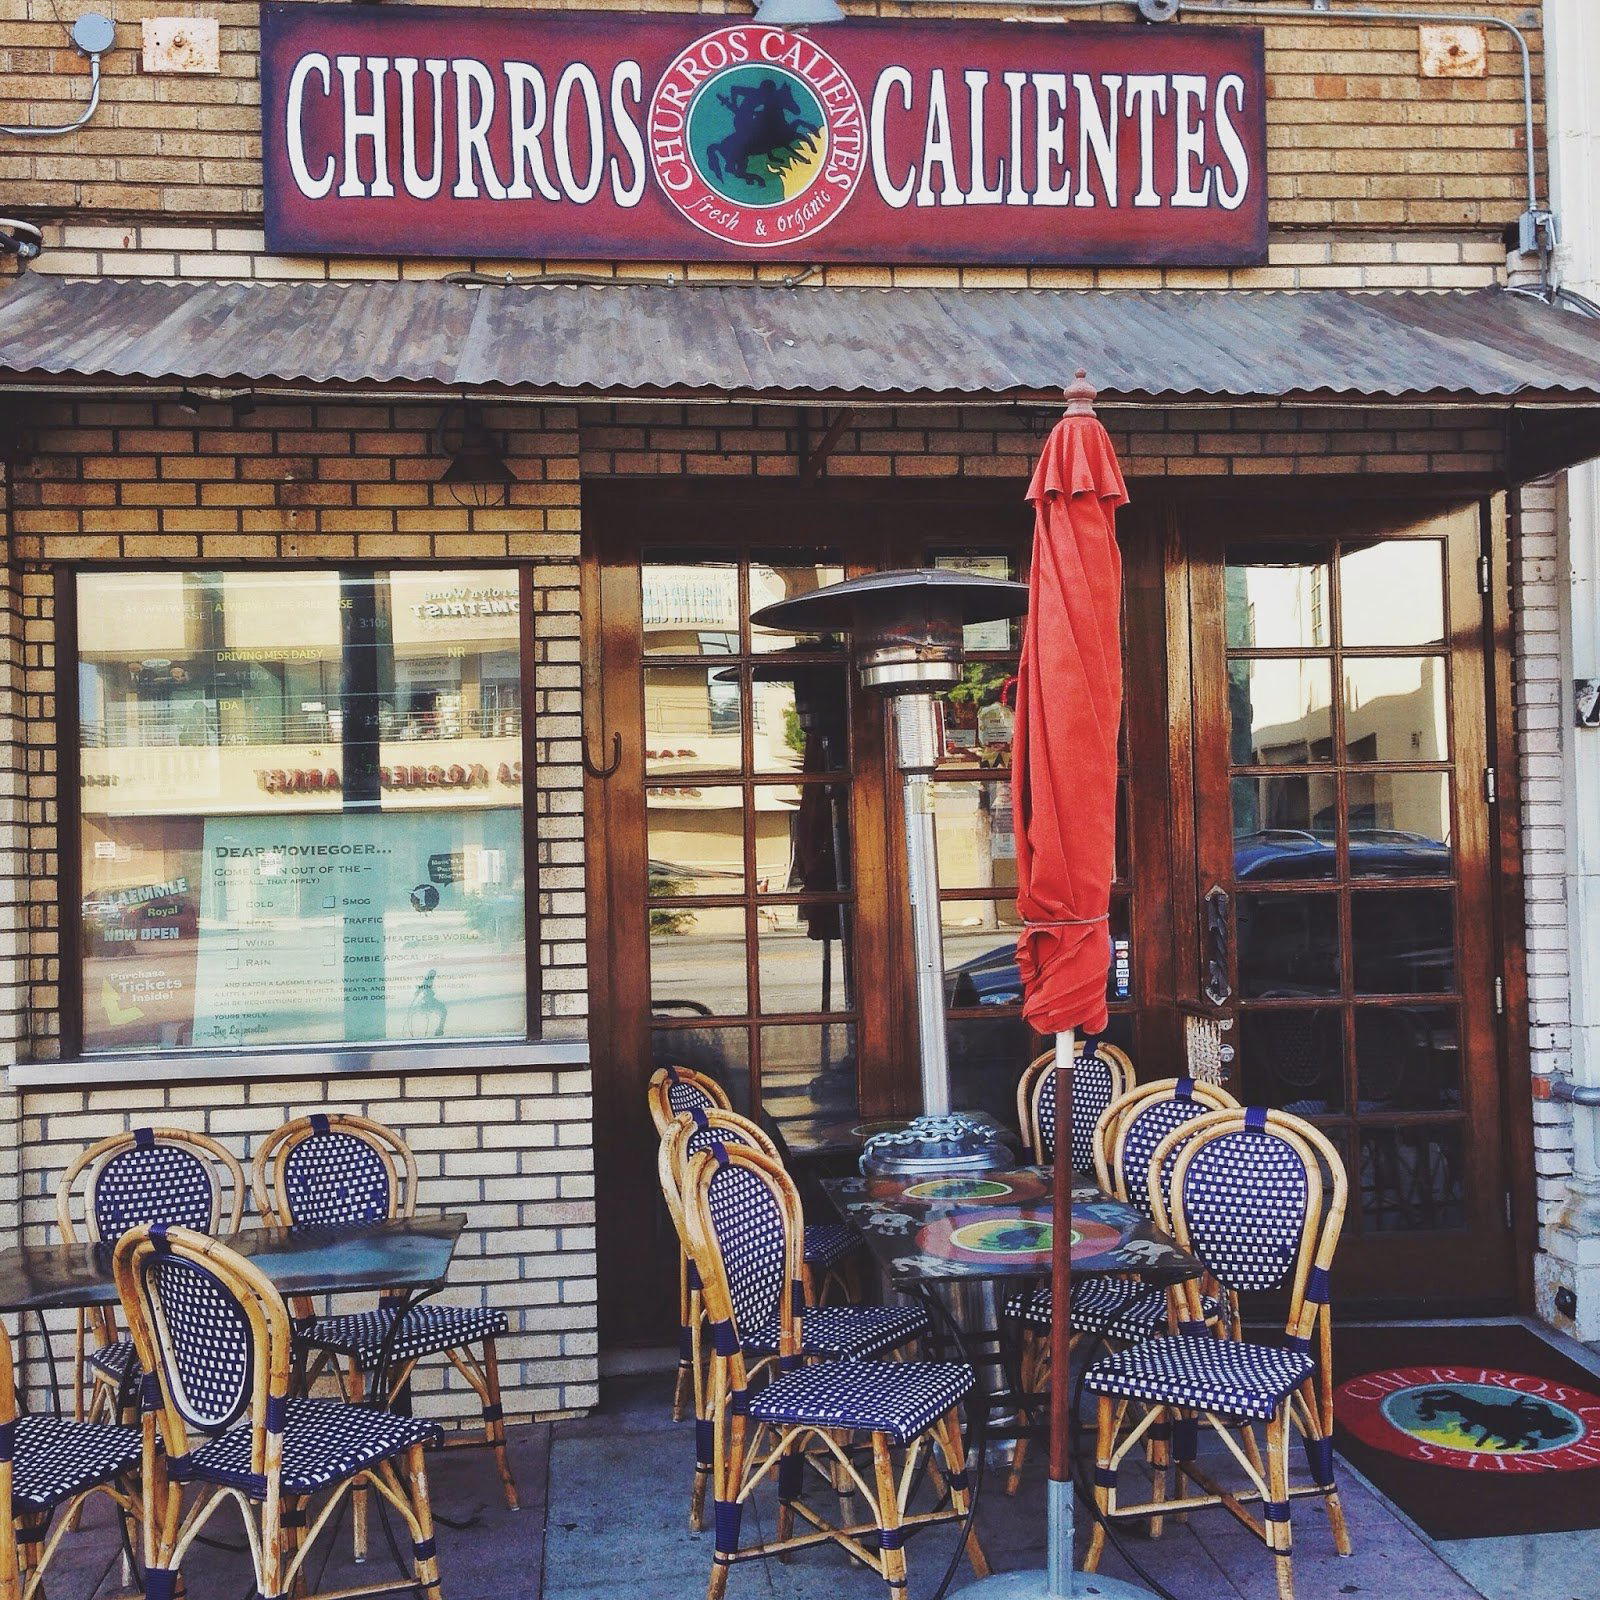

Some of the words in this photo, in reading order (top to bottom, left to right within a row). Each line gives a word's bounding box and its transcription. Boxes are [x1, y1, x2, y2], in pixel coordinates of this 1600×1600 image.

[653, 31, 749, 191] CHURROS
[760, 31, 862, 191] CALIENTES
[286, 52, 645, 207] CHURROS
[871, 65, 1249, 210] CALIENTES
[683, 194, 740, 231] fresh
[755, 219, 767, 237] &
[777, 190, 832, 233] organic
[216, 650, 262, 662] DRIVING
[264, 649, 289, 660] MISS
[291, 648, 324, 659] DAISY
[447, 646, 466, 657] NR
[219, 700, 239, 711] IDA
[291, 866, 316, 876] OUT
[318, 865, 334, 875] OF
[337, 865, 360, 874] THE
[246, 900, 274, 909] COLD
[342, 897, 371, 906] SMOG
[148, 905, 178, 919] Royal
[342, 915, 384, 925] TRAFFIC
[104, 929, 138, 942] NOW
[140, 926, 180, 940] OPEN
[245, 939, 275, 948] WIND
[342, 936, 380, 945] CRUEL,
[382, 934, 439, 944] HEARTLESS
[442, 932, 479, 942] WORLD
[246, 958, 272, 968] RAIN
[342, 954, 381, 964] ZOMBIE
[118, 978, 182, 993] Tickets
